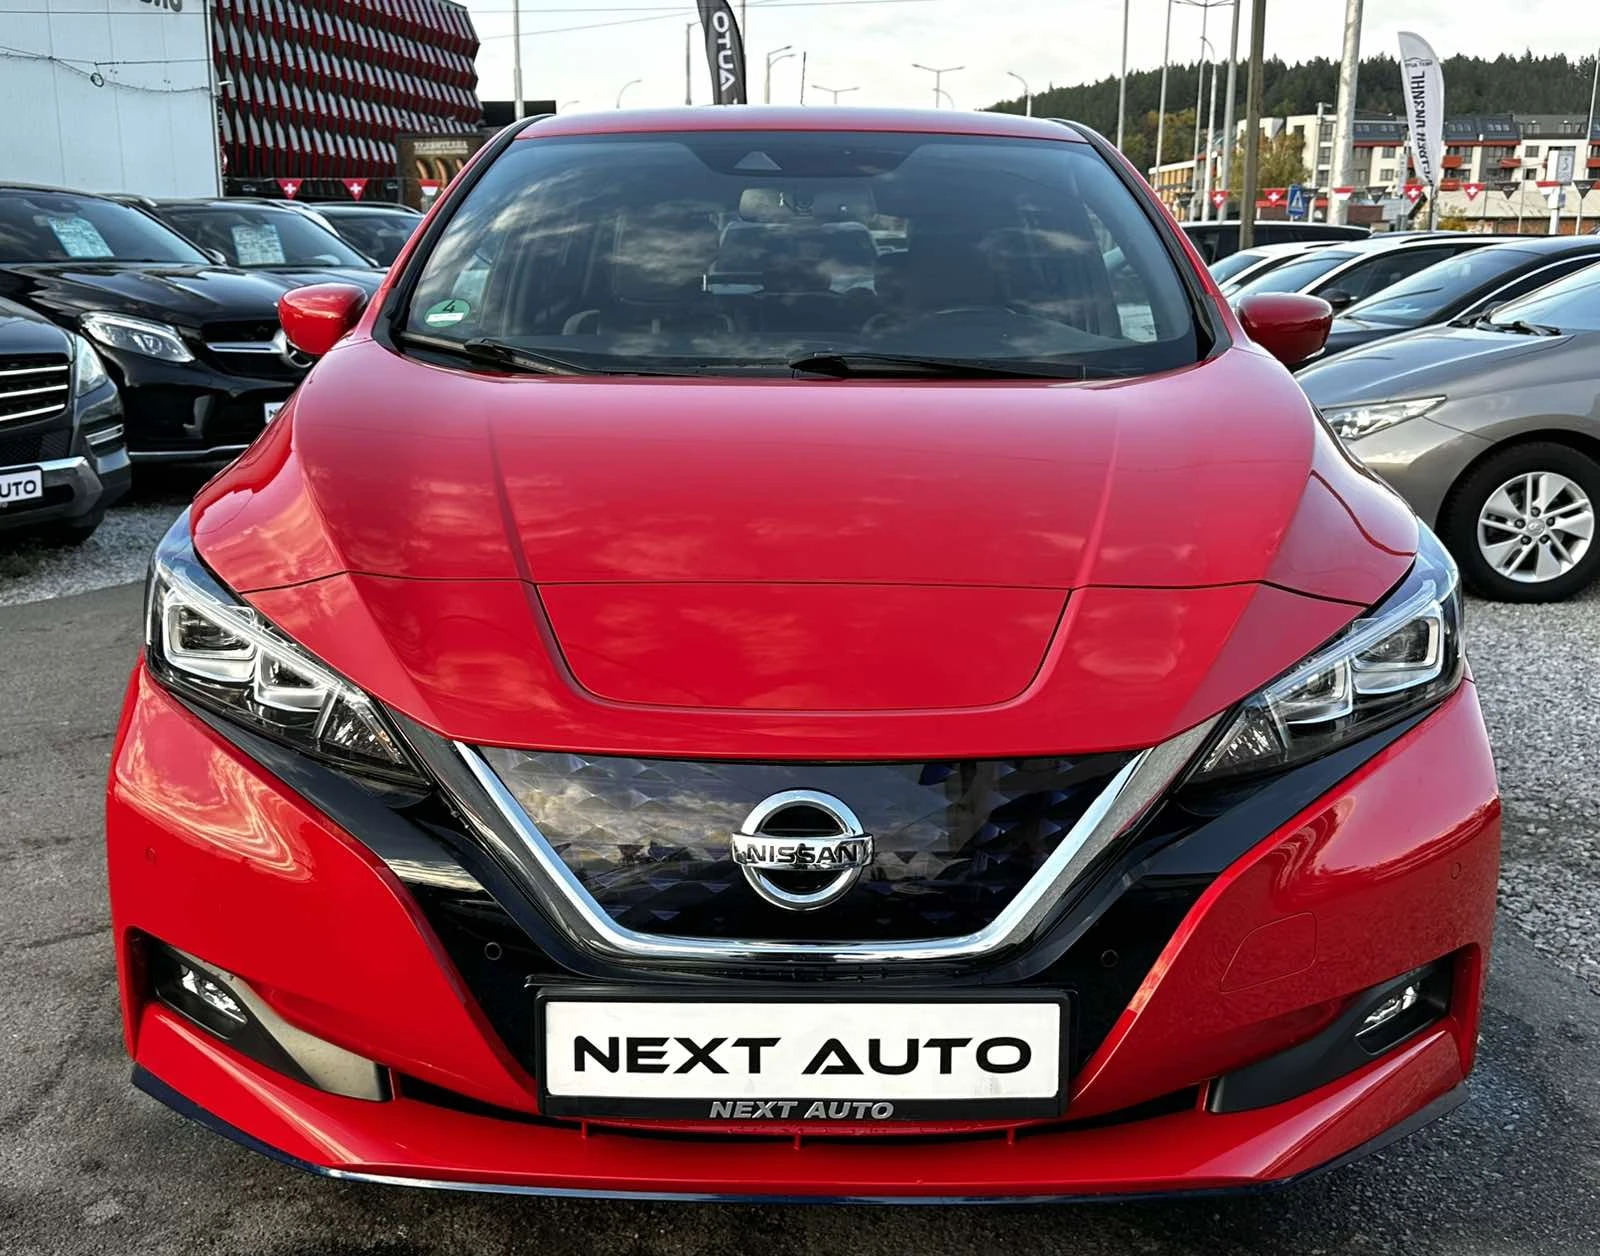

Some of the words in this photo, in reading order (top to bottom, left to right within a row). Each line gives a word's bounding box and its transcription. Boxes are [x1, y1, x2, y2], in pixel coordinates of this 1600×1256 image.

[747, 843, 858, 864] NISSAN
[574, 1035, 782, 1074] NEXT
[801, 1036, 1032, 1075] AUTO
[709, 1101, 798, 1119] NEXT
[803, 1101, 894, 1119] AUTO
